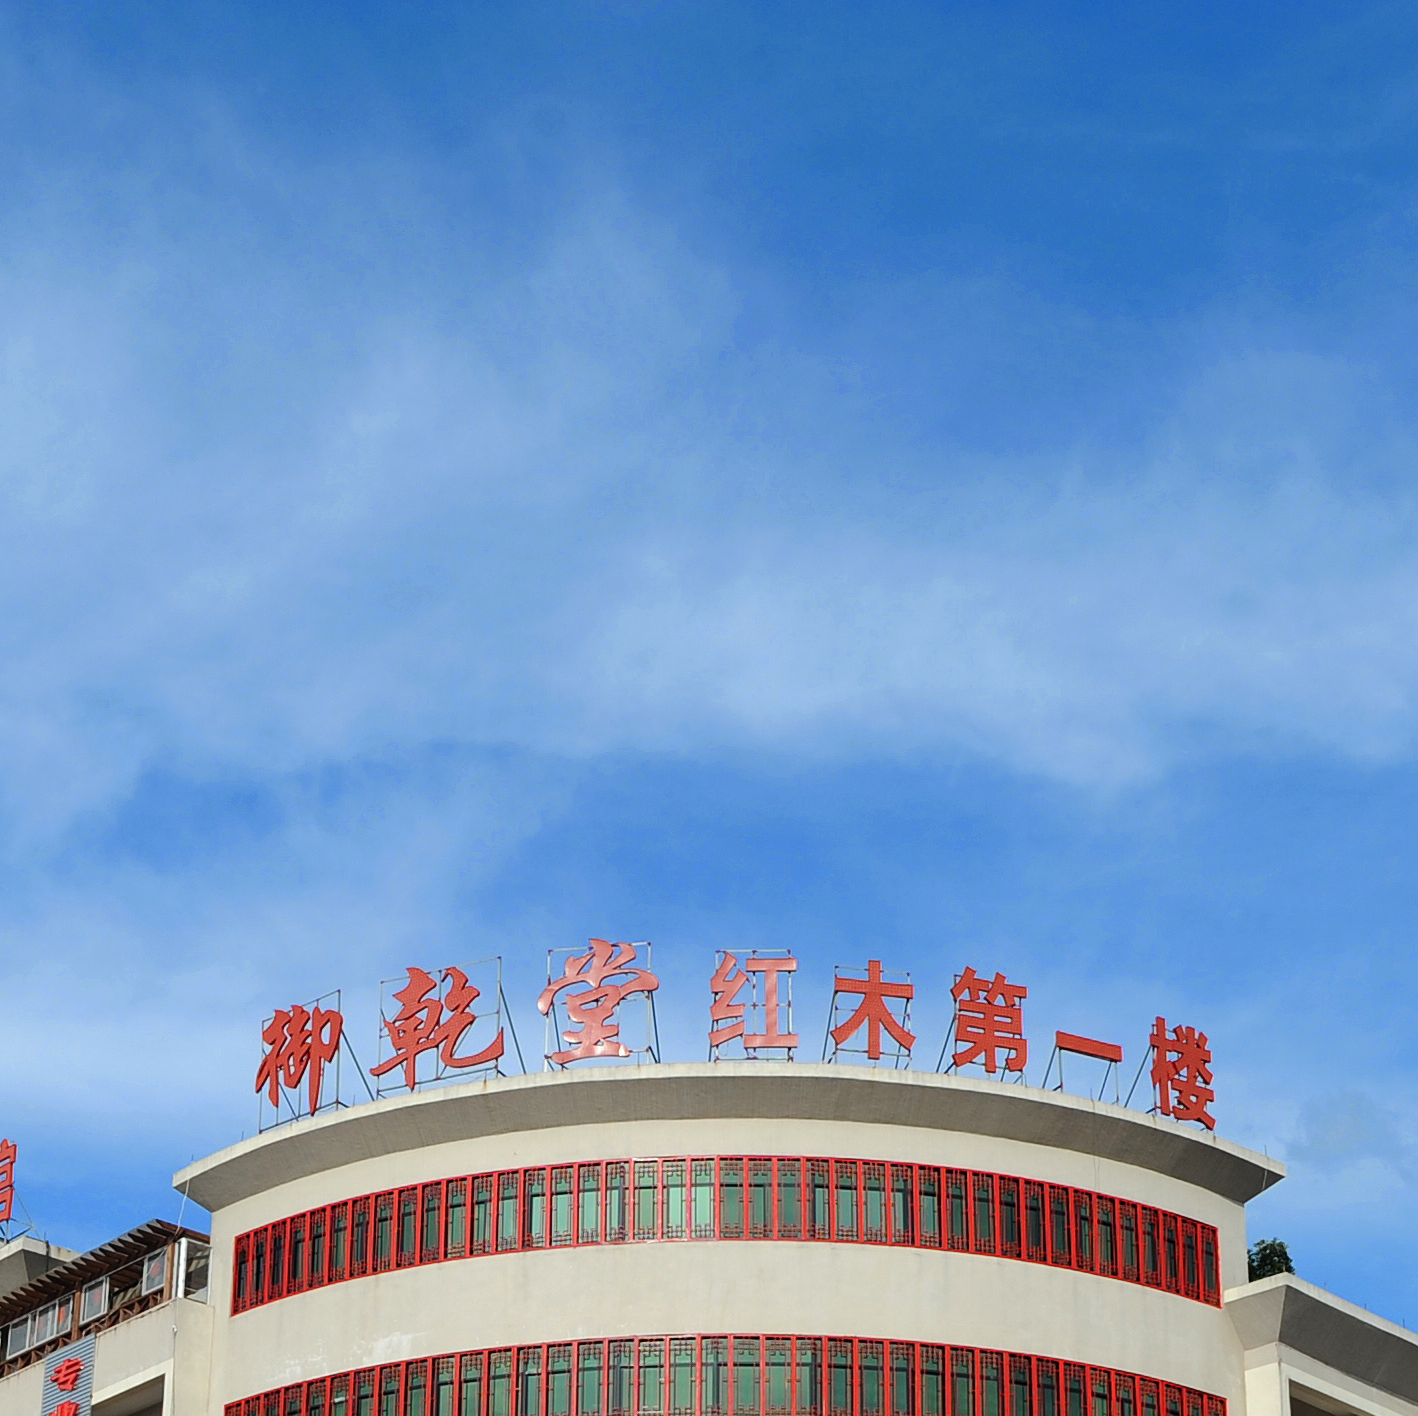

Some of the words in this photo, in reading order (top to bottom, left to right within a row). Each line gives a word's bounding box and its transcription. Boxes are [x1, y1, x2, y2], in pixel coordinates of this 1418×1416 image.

[254, 938, 1217, 1130] 御乾堂红木第一楼
